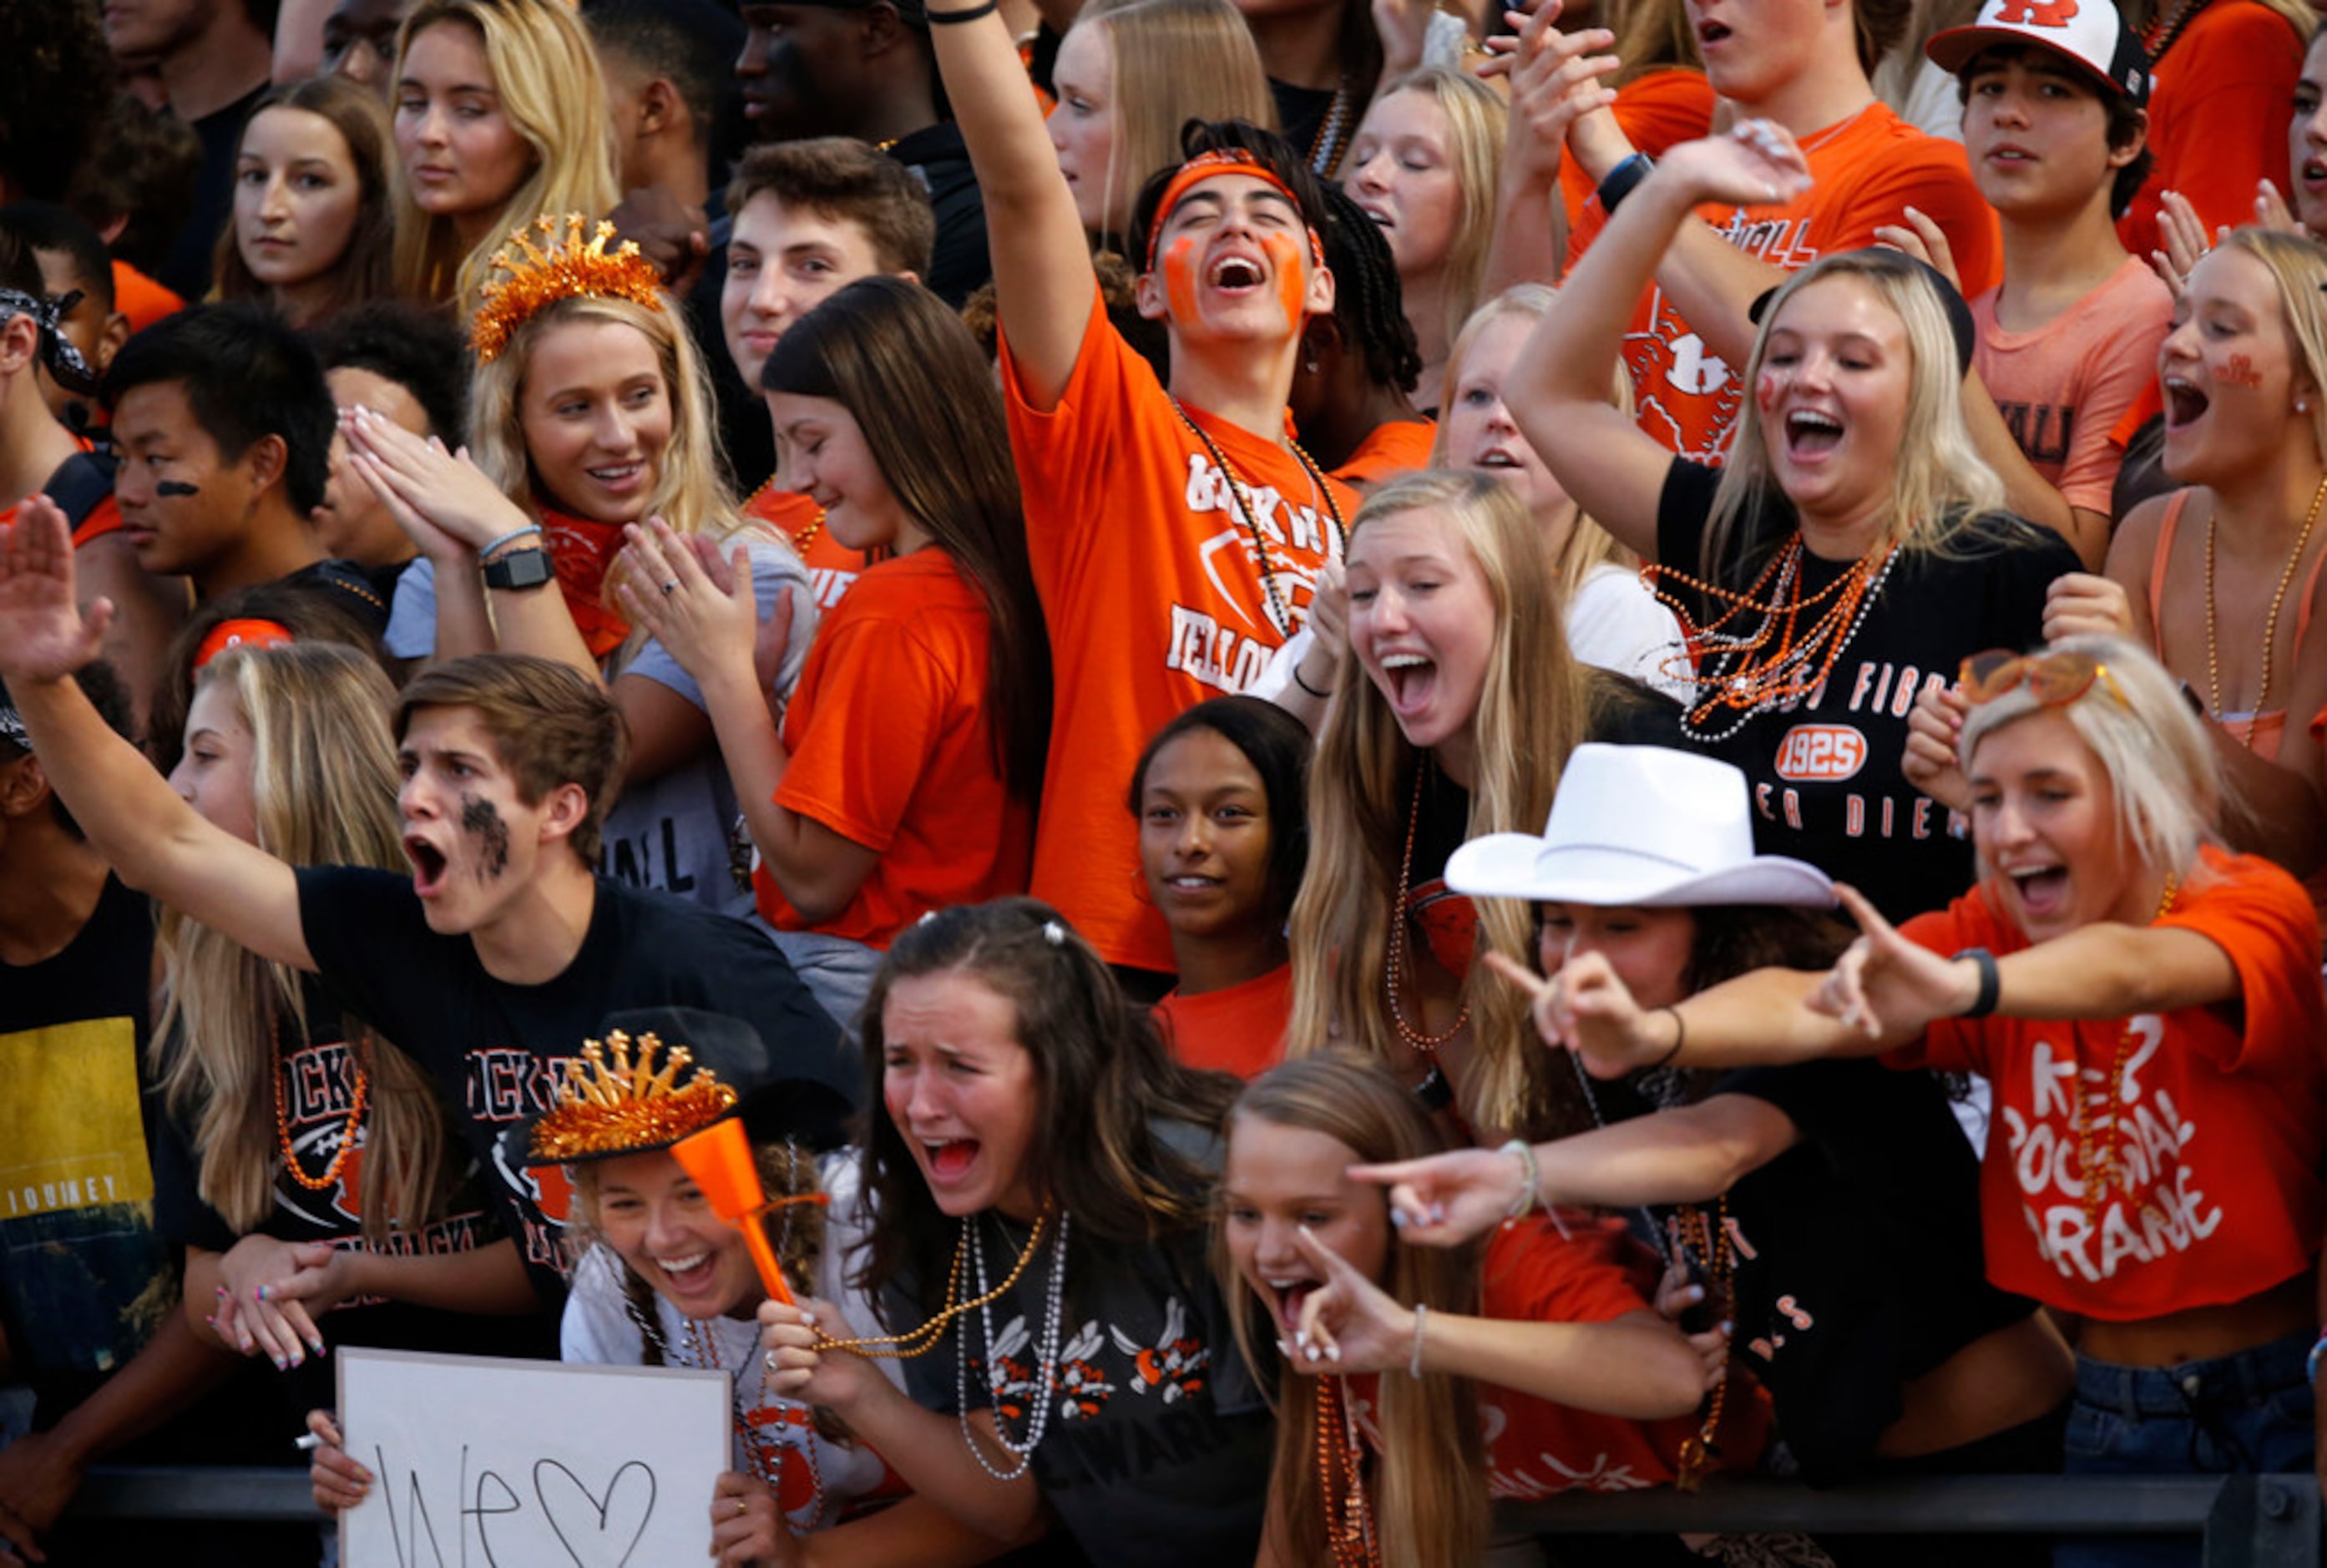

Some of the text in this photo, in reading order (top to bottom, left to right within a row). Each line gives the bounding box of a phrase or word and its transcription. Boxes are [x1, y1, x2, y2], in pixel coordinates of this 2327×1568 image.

[1994, 0, 2079, 28] R
[1849, 662, 1962, 718] FIG
[1780, 732, 1857, 775] 1925
